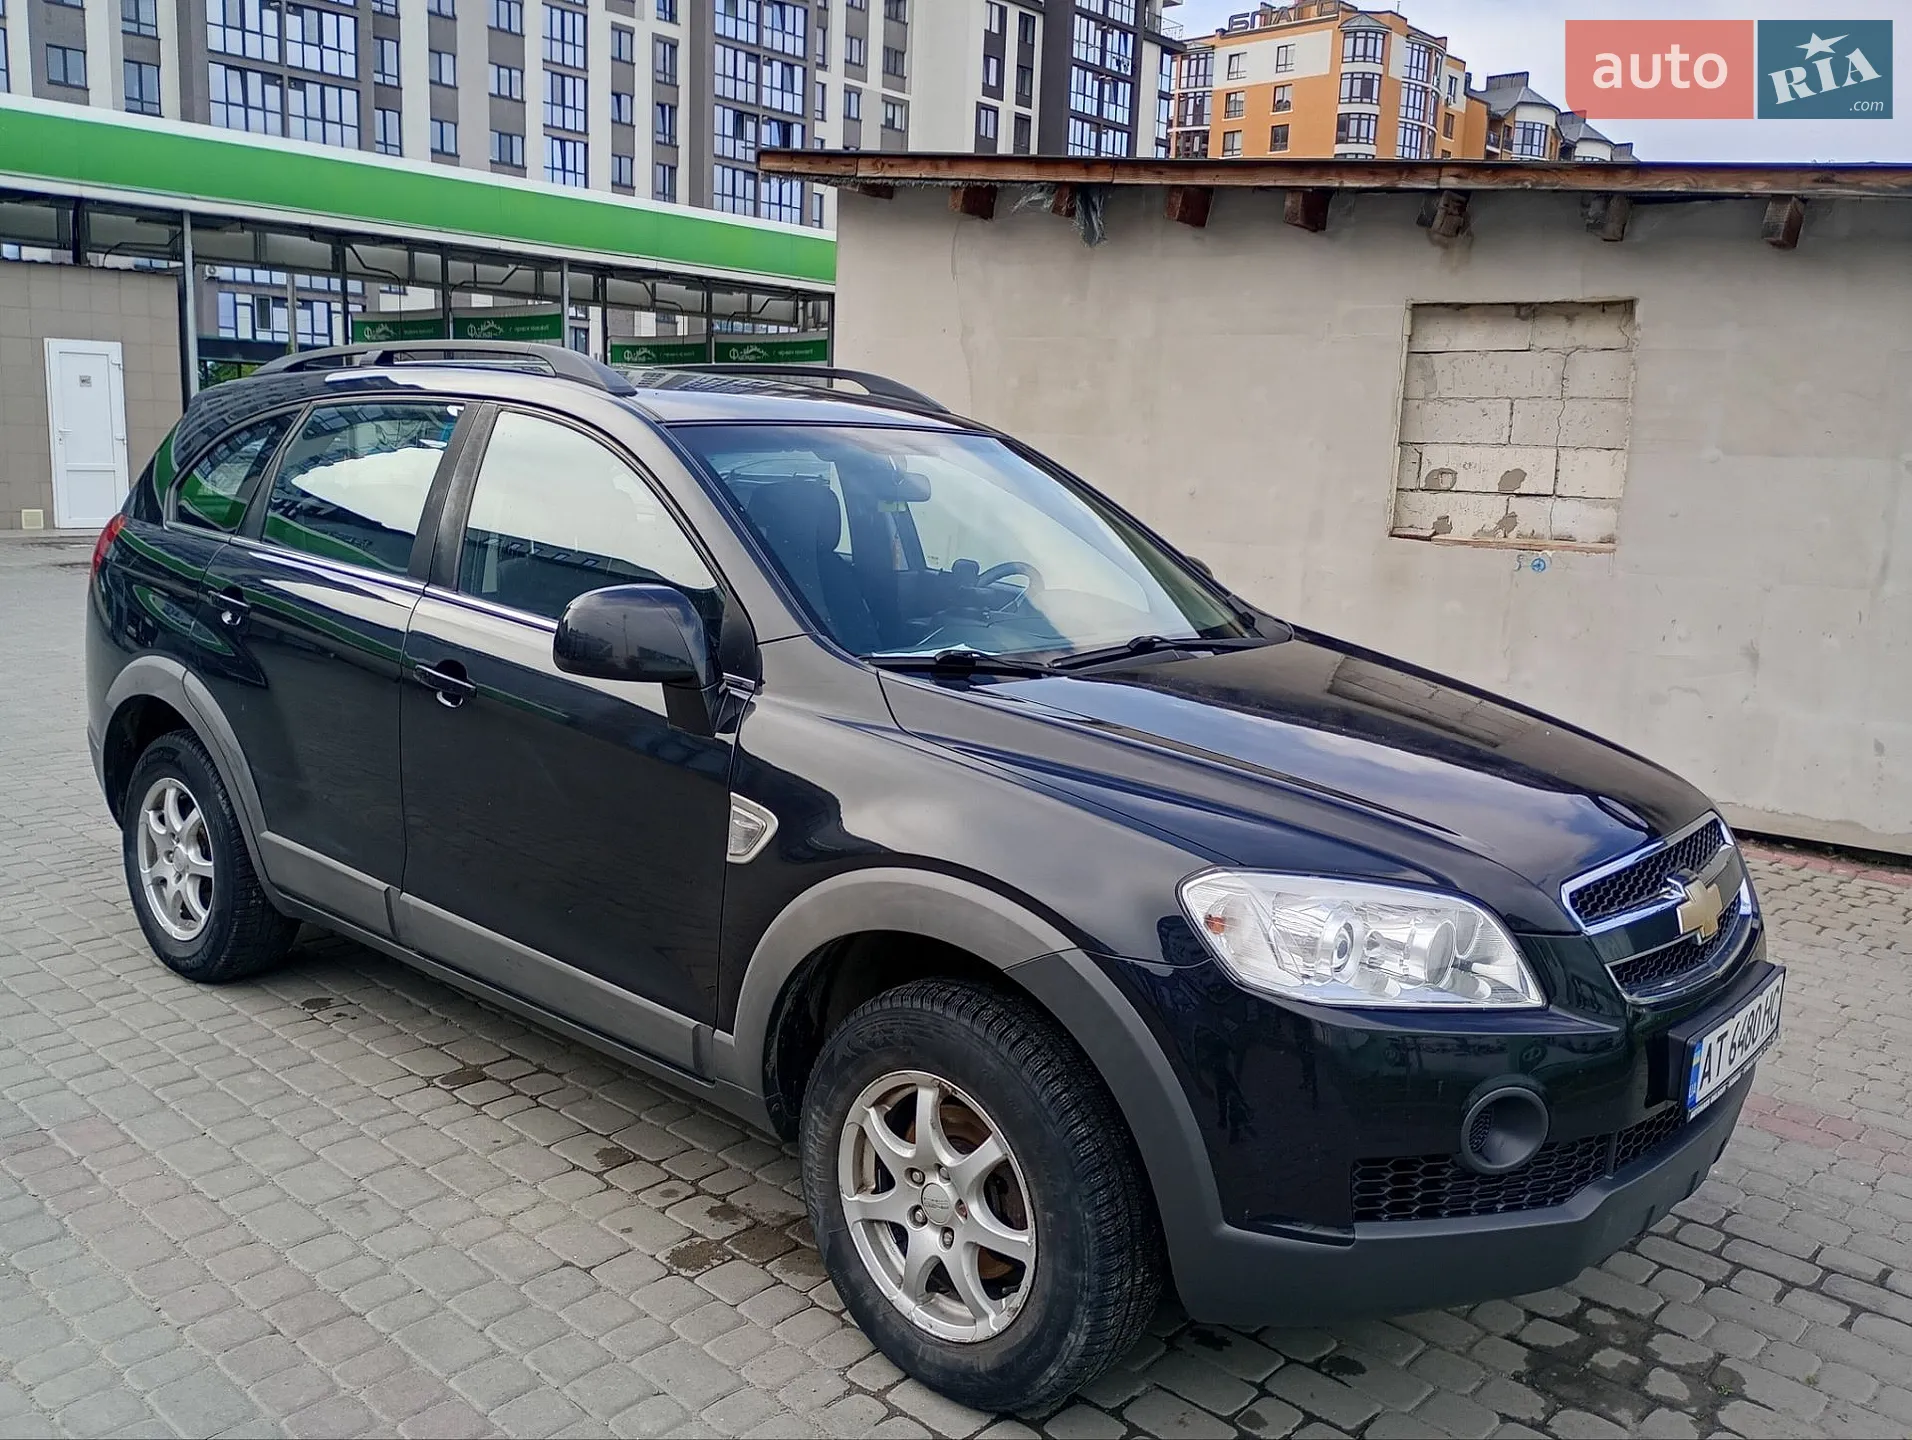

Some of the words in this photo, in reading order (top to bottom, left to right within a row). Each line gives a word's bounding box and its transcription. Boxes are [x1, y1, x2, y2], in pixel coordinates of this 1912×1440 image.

[1699, 1030, 1728, 1091] AT
[1728, 1003, 1762, 1066] 6480
[1760, 985, 1780, 1036] HC
